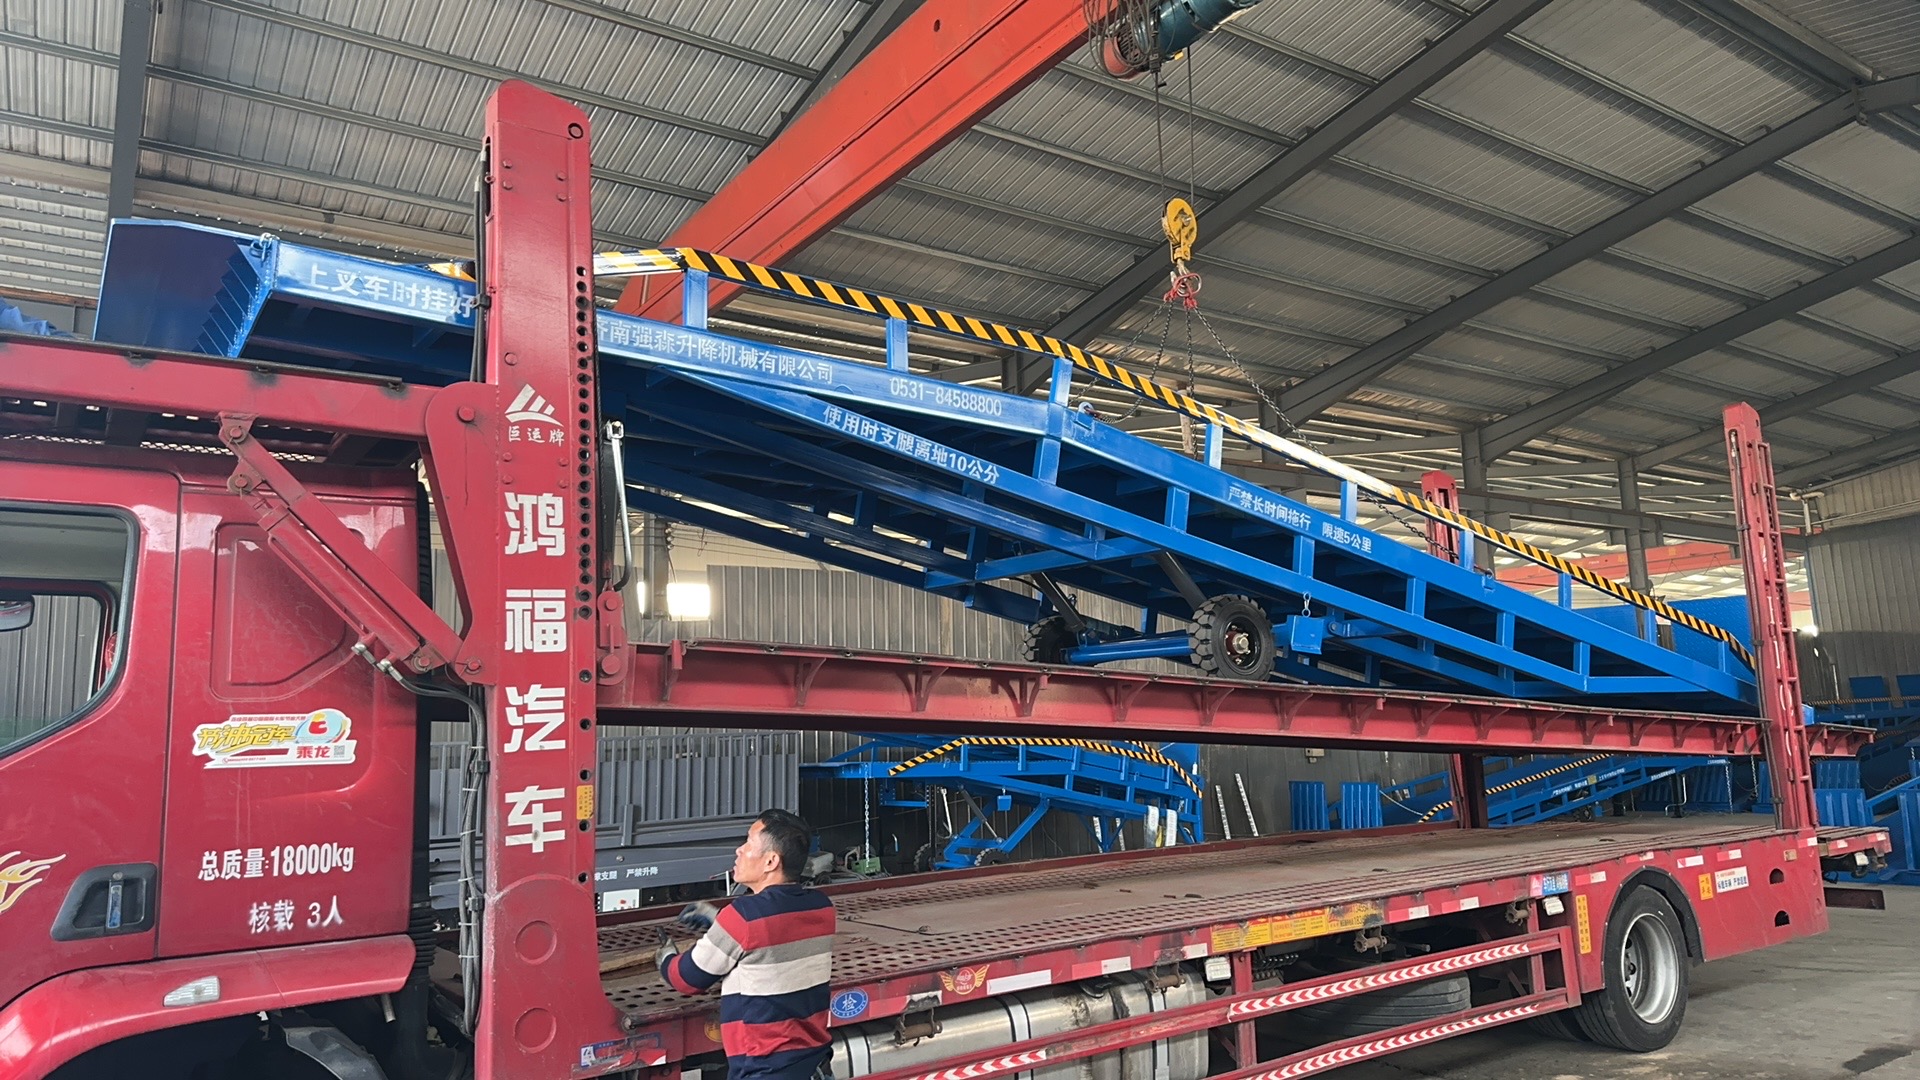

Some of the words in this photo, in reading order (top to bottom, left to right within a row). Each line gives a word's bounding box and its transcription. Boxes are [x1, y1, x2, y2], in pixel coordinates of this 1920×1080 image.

[310, 262, 474, 319] 上叉车时挂好
[889, 377, 1002, 417] 0531-84588800
[823, 404, 1000, 485] 使用时支腿离地10公分
[1227, 485, 1312, 531] 严禁长时间拖行
[1321, 521, 1372, 554] 限速5公里
[504, 492, 567, 854] 鸿福汽车
[197, 722, 297, 752] 节油冠军
[296, 745, 331, 759] 乘龙
[248, 899, 295, 934] 核载
[306, 895, 344, 929] 3人
[842, 993, 858, 1011] 检
